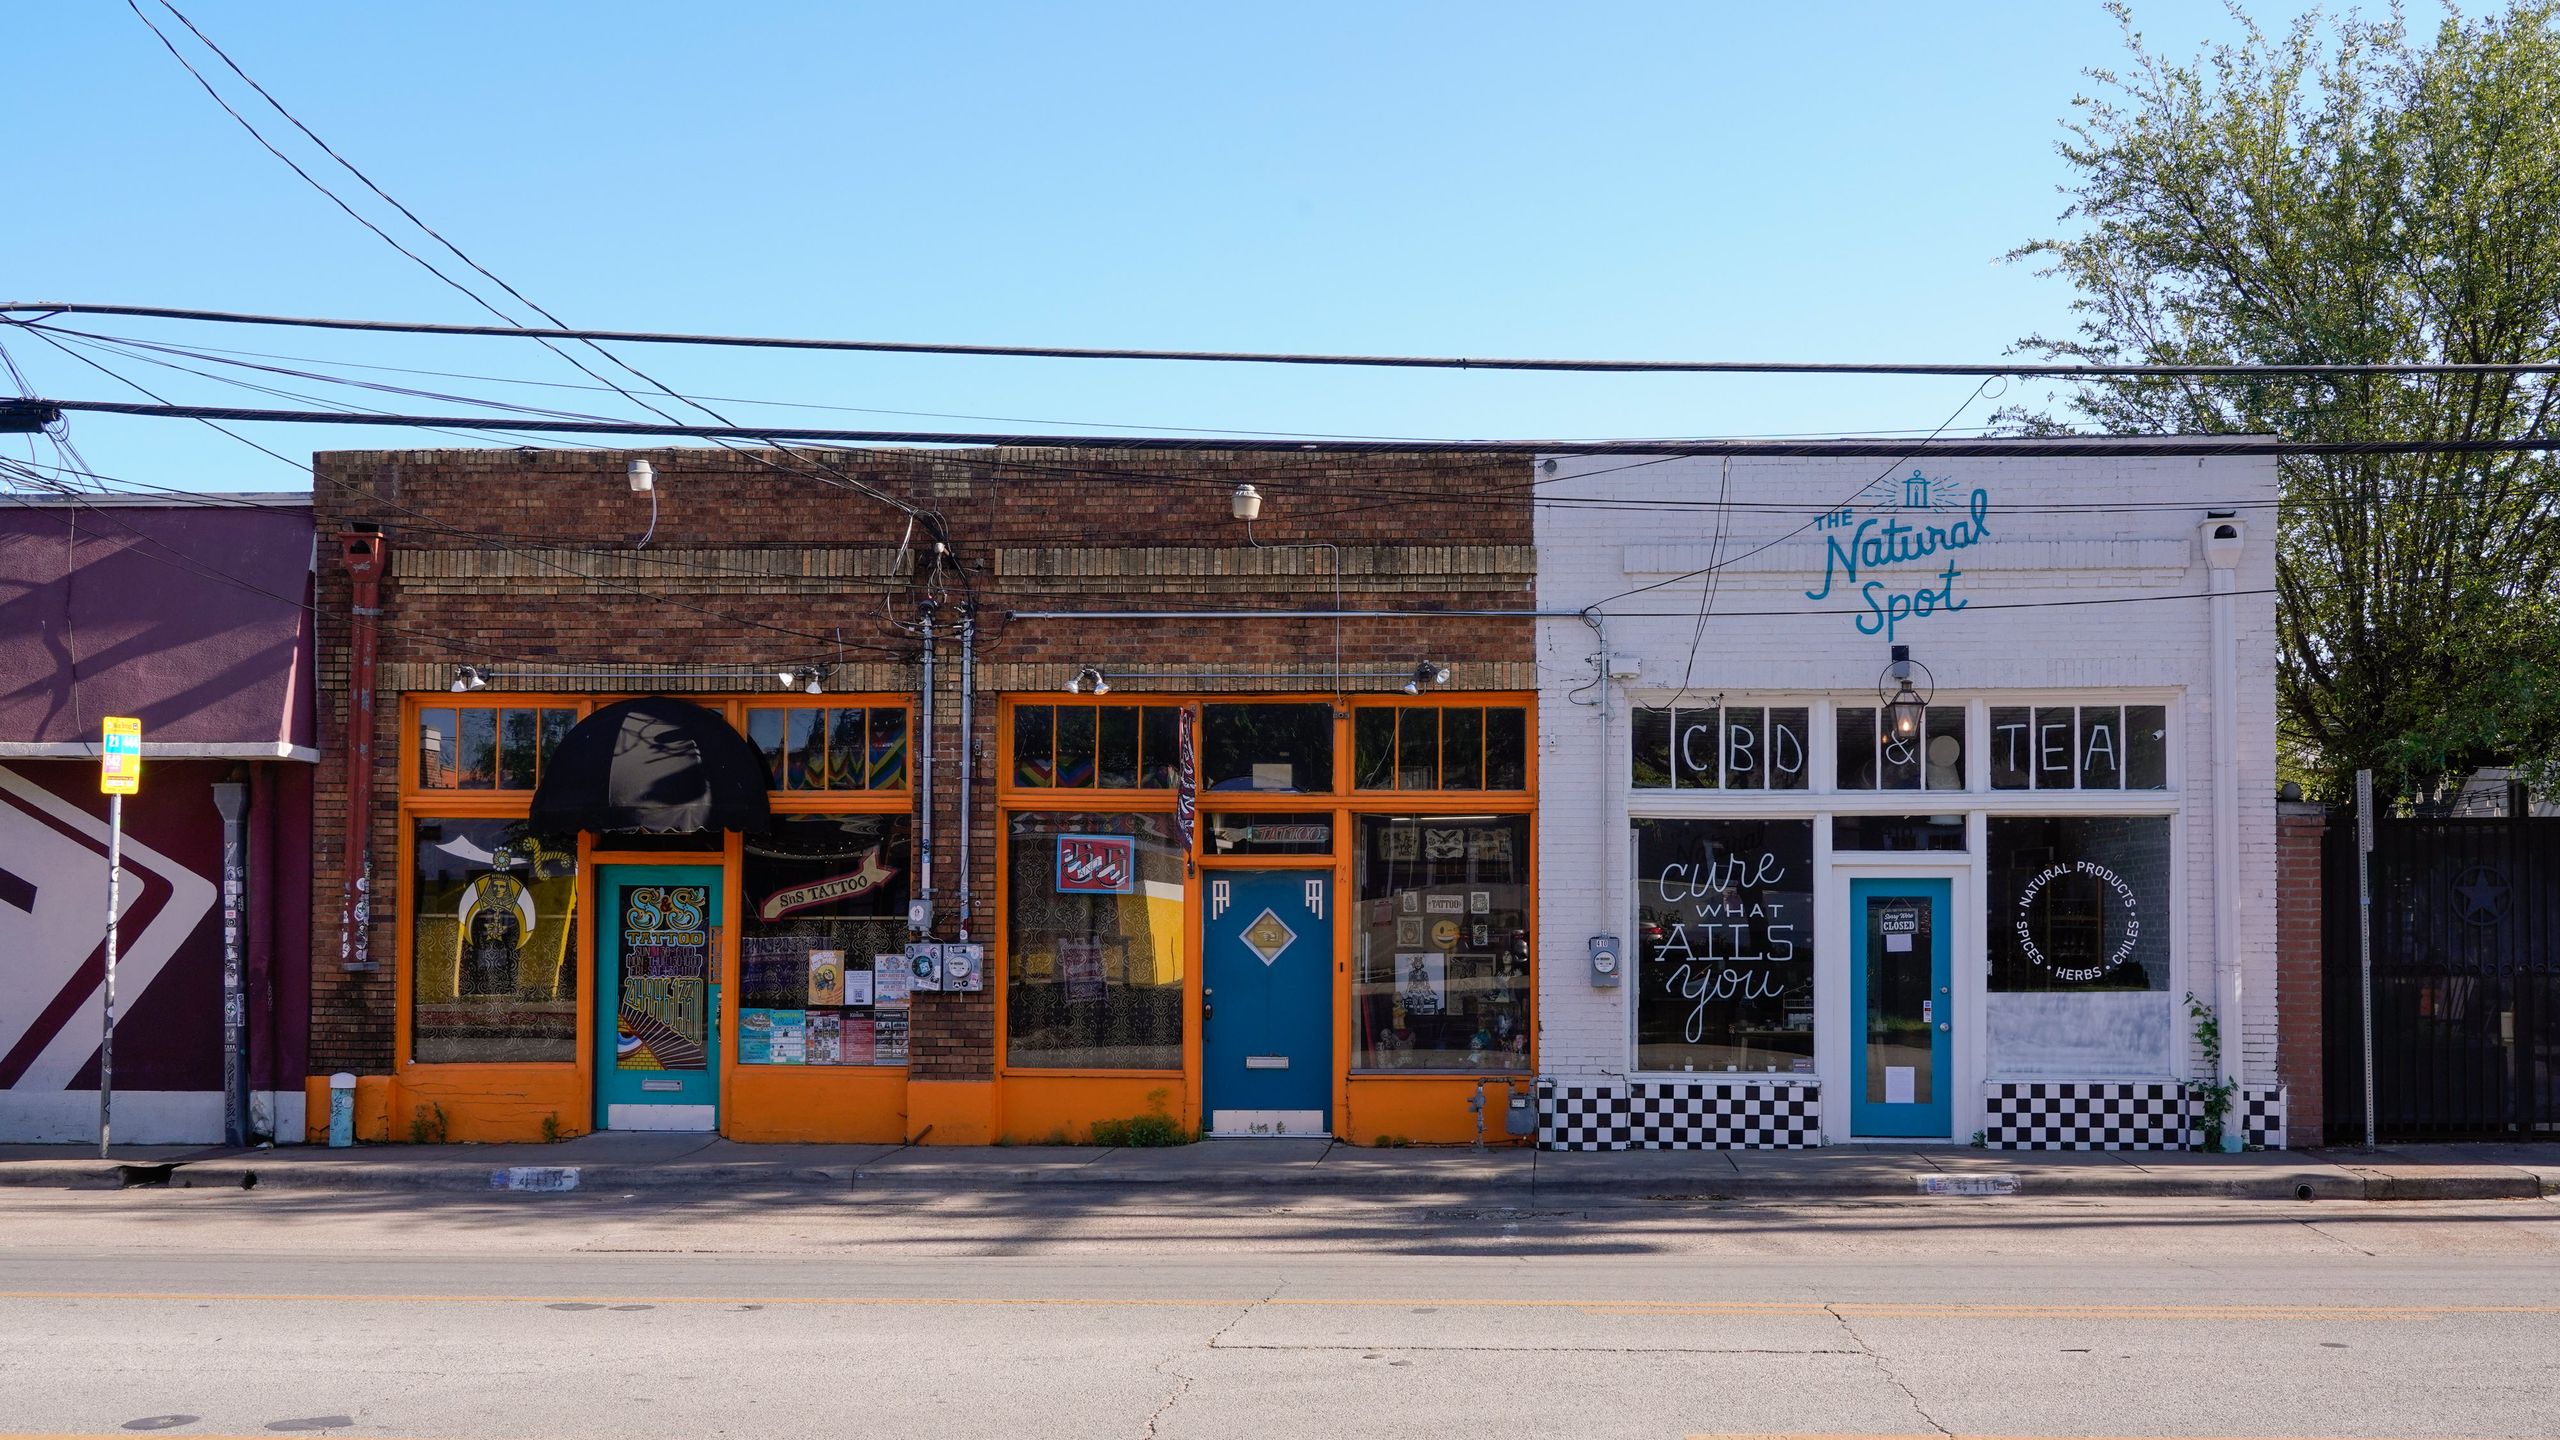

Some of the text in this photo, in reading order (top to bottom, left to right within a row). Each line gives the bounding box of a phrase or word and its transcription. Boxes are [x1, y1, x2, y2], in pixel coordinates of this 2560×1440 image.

[1814, 509, 1853, 531] THE
[1805, 488, 1991, 600] Natural
[1856, 559, 1968, 643] Spot
[1683, 723, 2117, 774] CBD & TEA
[1260, 826, 1321, 841] TATTOO
[808, 875, 868, 901] TATTOO
[2019, 861, 2136, 908] NATURAL PRODUCTS
[1431, 899, 1460, 909] TATTOO
[1696, 903, 1784, 918] WHAT
[626, 931, 704, 945] TATTOO
[1883, 920, 1915, 931] CLOSED
[1653, 923, 1794, 962] AILS
[2016, 920, 2140, 981] SPICES HERBS CHILES
[1665, 963, 1785, 1043] you
